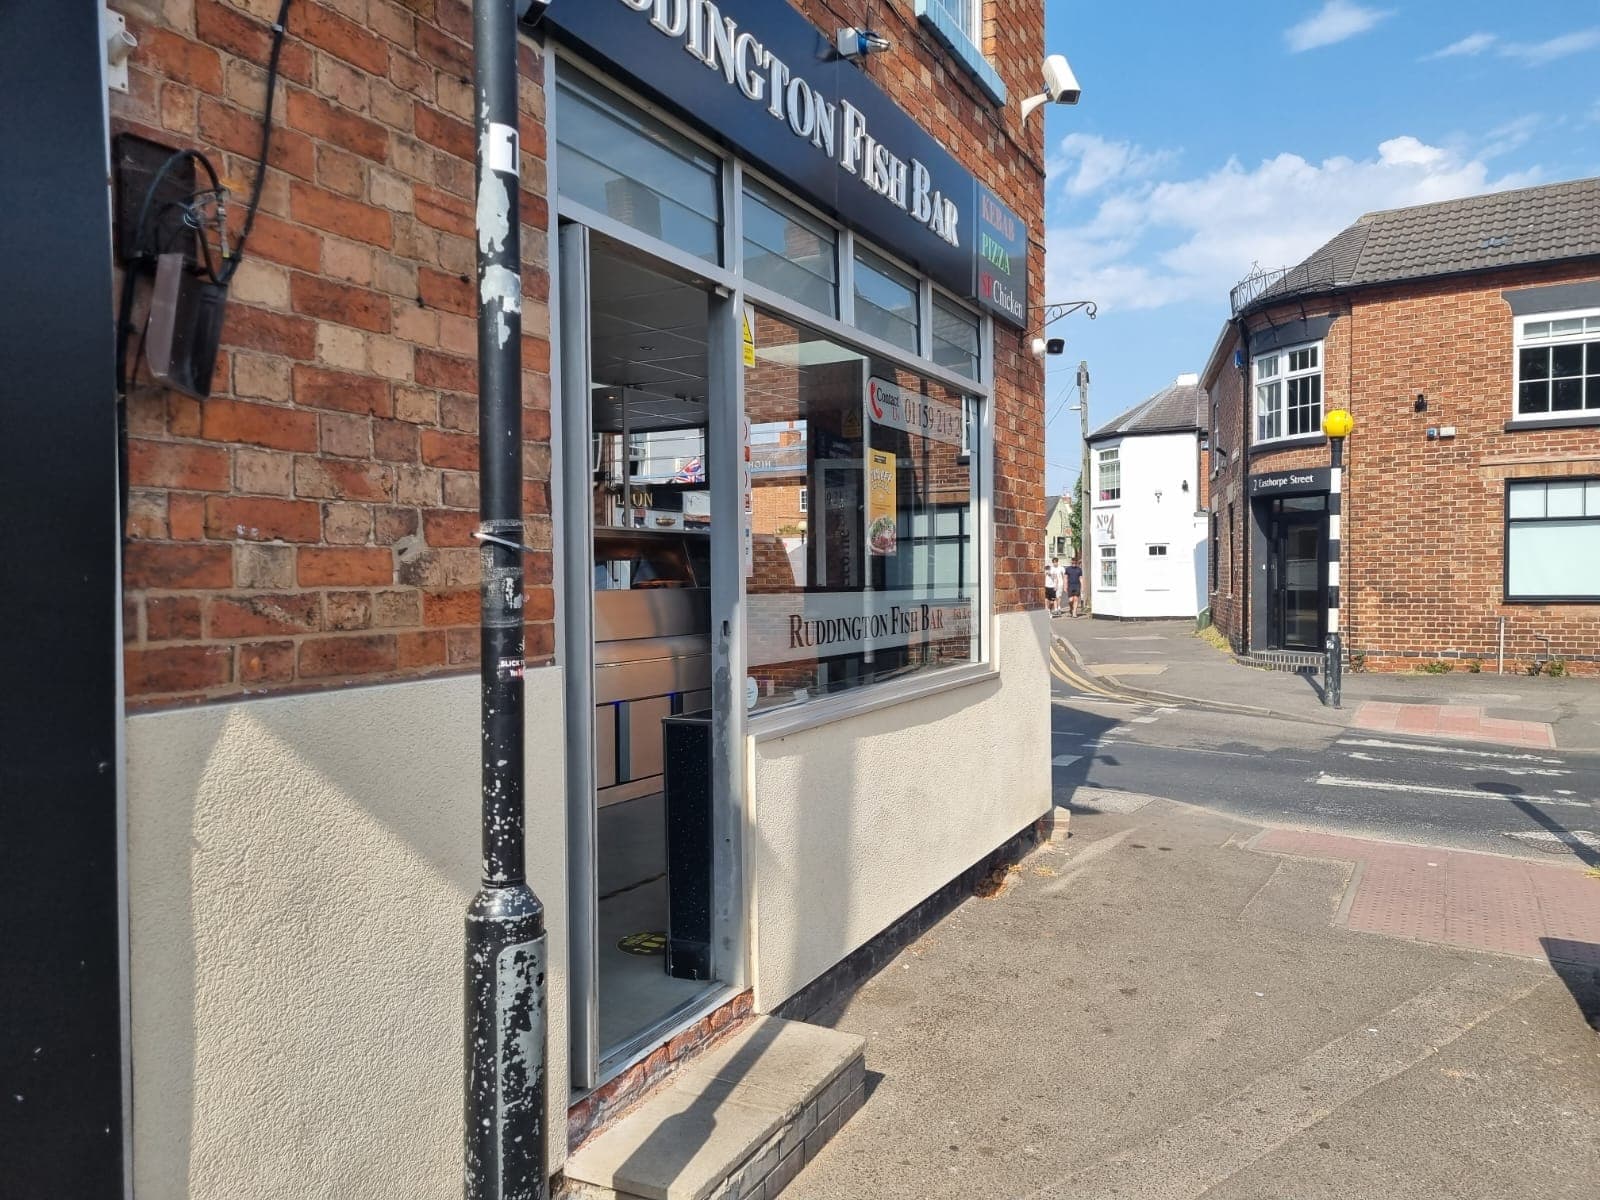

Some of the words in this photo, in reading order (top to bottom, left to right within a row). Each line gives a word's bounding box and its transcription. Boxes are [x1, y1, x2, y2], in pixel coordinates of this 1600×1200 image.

[620, 0, 835, 157] INGTON
[839, 100, 908, 206] FISH
[910, 158, 959, 248] BAR
[982, 195, 1015, 242] KEBAB
[982, 231, 1011, 276] PIZZA
[993, 280, 1023, 320] Chicken
[1258, 477, 1288, 488] Easthorpe
[1289, 474, 1315, 485] Street
[788, 614, 888, 649] RUDDINGTON
[891, 606, 918, 635] FISH
[921, 603, 944, 631] BAR
